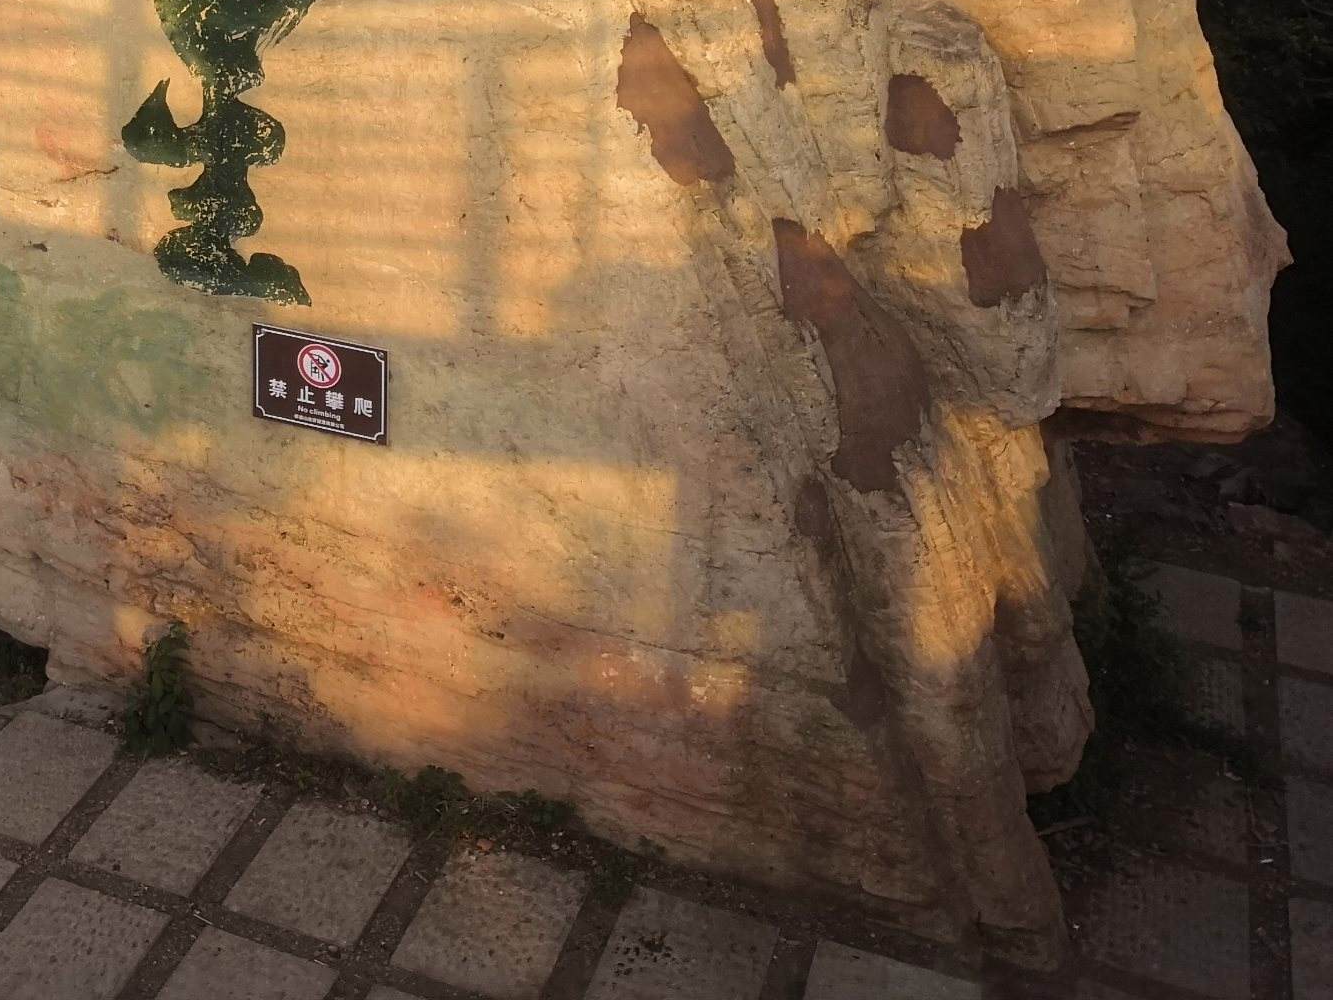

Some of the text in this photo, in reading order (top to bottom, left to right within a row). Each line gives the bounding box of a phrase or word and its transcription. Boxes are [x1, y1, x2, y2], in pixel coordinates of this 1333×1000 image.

[268, 378, 373, 418] 禁止攀爬
[297, 405, 308, 413] No
[309, 408, 341, 422] climbing
